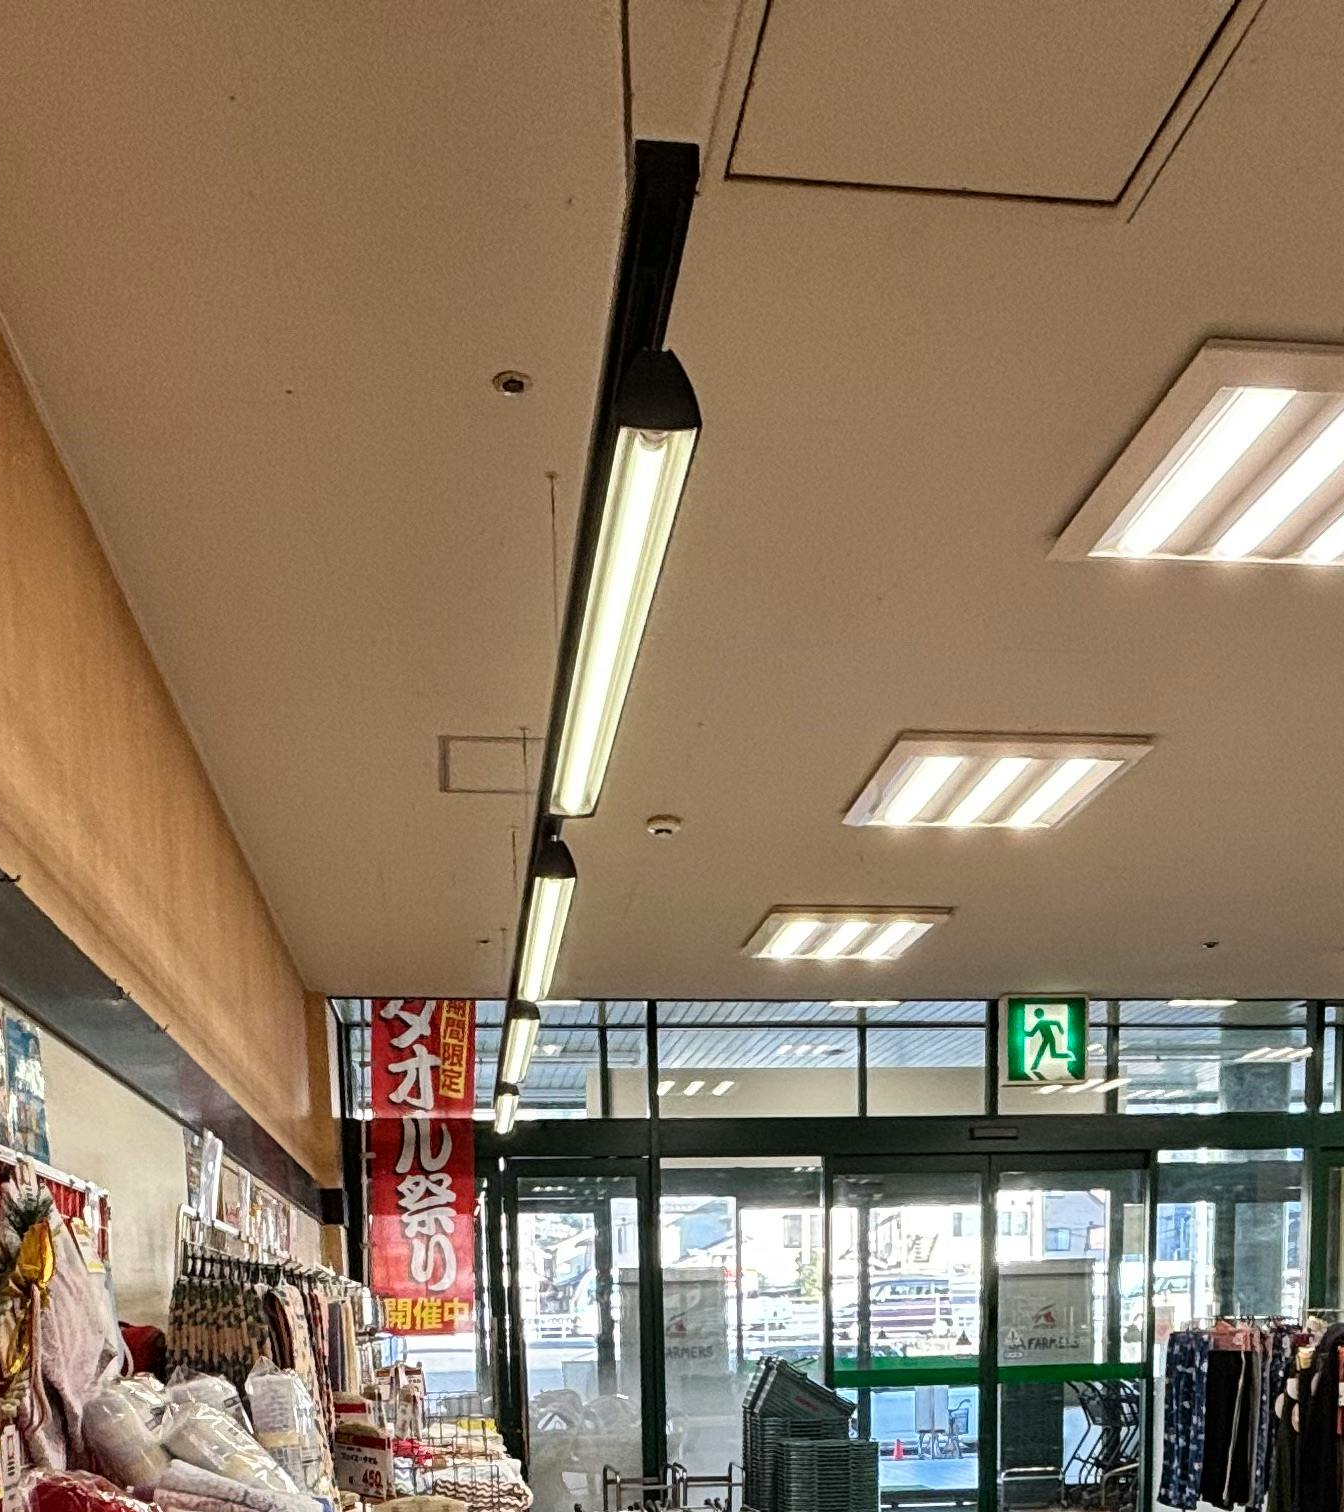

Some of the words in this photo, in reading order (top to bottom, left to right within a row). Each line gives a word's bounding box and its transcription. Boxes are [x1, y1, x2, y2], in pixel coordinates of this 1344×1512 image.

[379, 1000, 458, 1292] タオル祭り
[384, 1297, 471, 1331] 開催中
[665, 1345, 713, 1360] ARMERS
